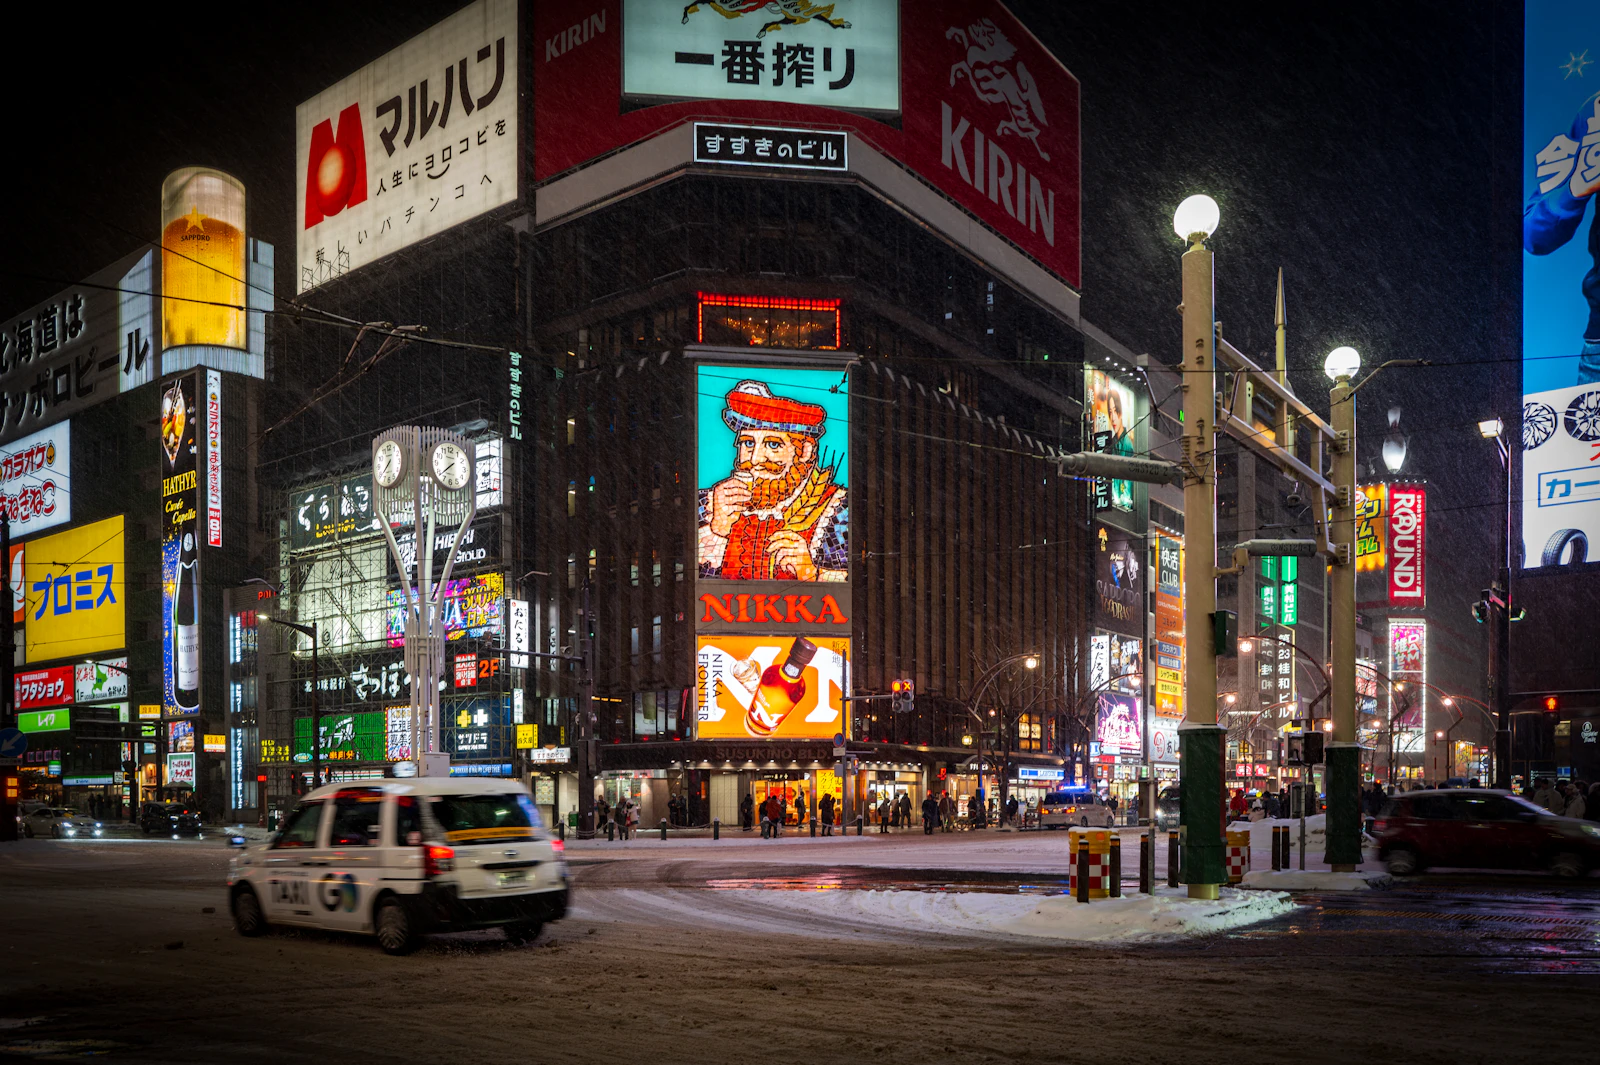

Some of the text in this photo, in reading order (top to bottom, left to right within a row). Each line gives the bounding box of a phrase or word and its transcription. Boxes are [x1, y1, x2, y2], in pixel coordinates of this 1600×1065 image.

[545, 8, 607, 63] KIRIN
[674, 40, 856, 90] 一番搾り
[376, 36, 506, 159] マルハン
[376, 118, 507, 197] 人生にヨロコビを
[704, 134, 838, 161] すすきのビル
[941, 100, 1055, 248] KIRIN
[315, 174, 493, 265] 新しいパチンコへ
[181, 234, 211, 242] SAPPORO
[509, 351, 523, 441] すすきのビル
[209, 401, 219, 440] カラオケ
[3, 445, 46, 480] カラオケ
[163, 470, 197, 497] HATHYR
[172, 508, 196, 525] Capella
[1161, 546, 1178, 571] 快活
[1393, 493, 1421, 597] ROUND1
[32, 563, 117, 621] プロミス
[1161, 570, 1178, 588] CLUB
[699, 592, 849, 624] NIKKA
[478, 658, 499, 679] 2F
[712, 653, 723, 698] NIKKA
[21, 677, 64, 701] ワタショウ
[698, 653, 709, 721] FRONTIER
[38, 713, 56, 727] レイク
[457, 732, 488, 744] サツドラ
[716, 748, 831, 761] SUSUKINO BLD.
